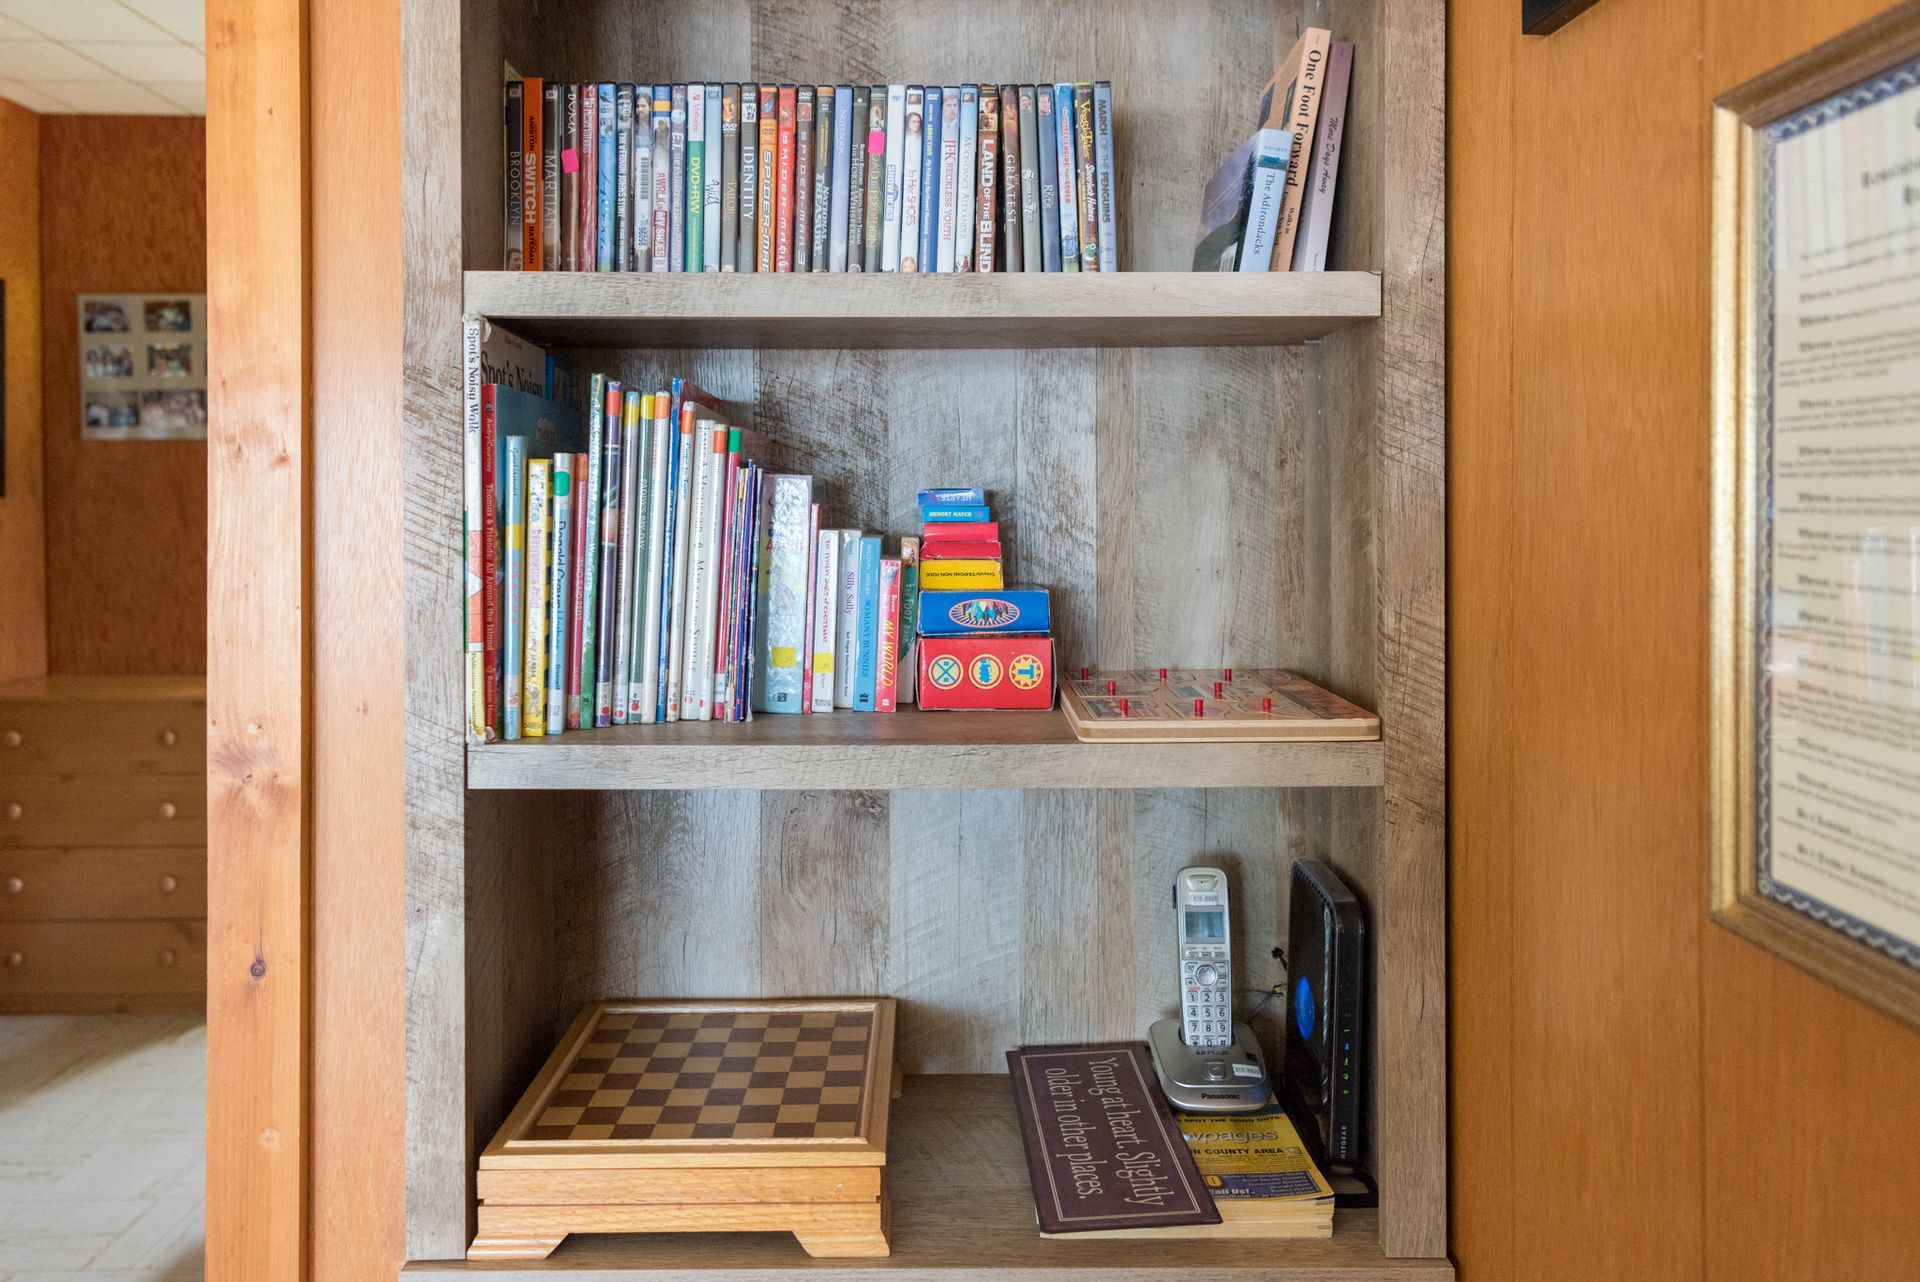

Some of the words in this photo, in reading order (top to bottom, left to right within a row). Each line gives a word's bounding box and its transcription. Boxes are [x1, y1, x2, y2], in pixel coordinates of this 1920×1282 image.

[1308, 49, 1322, 81] One
[1301, 85, 1316, 118] Foot
[838, 109, 848, 155] NOTEBOOK
[1079, 99, 1093, 160] VeggieTales
[1097, 99, 1108, 136] MARCH
[1325, 117, 1339, 141] More
[618, 132, 626, 145] THE
[671, 132, 684, 150] E.T.
[943, 138, 956, 162] JFK
[1099, 138, 1108, 152] OF
[618, 145, 627, 173] VERNON
[962, 136, 972, 189] MOONDANCE
[981, 139, 995, 187] LAND
[1100, 153, 1109, 170] THE
[1285, 123, 1309, 188] Forward
[1322, 142, 1335, 168] Days
[510, 151, 521, 225] BROOKLYN
[525, 153, 536, 224] SWITCH
[618, 174, 626, 197] JOHNS
[690, 157, 700, 214] DVD+RW
[743, 146, 754, 220] IDENTITY
[850, 158, 860, 190] HORSE
[907, 179, 916, 194] Her
[908, 169, 917, 178] In
[944, 162, 954, 208] RECKLESS
[1085, 164, 1095, 197] Sheerluck
[1264, 172, 1276, 192] The
[1319, 168, 1331, 194] Away
[545, 156, 557, 229] MARTIAN
[656, 178, 667, 203] WALK
[704, 180, 720, 206] Wild
[983, 187, 991, 198] OF
[1006, 154, 1016, 225] GREATEST
[1100, 171, 1111, 223] PENGUINS
[617, 197, 626, 218] STORY
[655, 211, 666, 226] MY
[813, 172, 824, 257] TREASURE
[821, 185, 830, 242] NATIONAL
[849, 190, 859, 246] WHISPERER
[906, 194, 916, 226] SHOES
[959, 190, 970, 240] ALEXANDER
[983, 198, 991, 220] THE
[1086, 197, 1097, 222] Holmes
[1285, 207, 1296, 226] Walks
[943, 209, 953, 240] YOUTH
[1253, 193, 1272, 255] Adirondacks
[1284, 227, 1291, 235] in
[655, 227, 666, 257] SHOES
[797, 249, 806, 266] 3
[980, 220, 992, 272] BLIND
[467, 328, 479, 363] Spot's
[468, 367, 479, 400] Noisy
[468, 402, 479, 433] Walk
[486, 484, 494, 517] Thomas
[486, 527, 495, 560] Friends:
[553, 521, 567, 565] Donald
[486, 563, 495, 574] All
[845, 571, 856, 591] Silly
[486, 576, 495, 605] Around
[843, 594, 855, 615] Sally
[864, 599, 872, 610] SO
[890, 594, 898, 612] Brown
[486, 608, 495, 621] the
[863, 610, 872, 638] MANY
[903, 598, 914, 622] FOOT
[486, 624, 495, 651] Island
[881, 618, 895, 640] MY
[861, 640, 871, 678] BUNNIES
[880, 641, 894, 687] WORLD
[1045, 1067, 1082, 1101] older
[1088, 1057, 1121, 1096] Young
[1053, 1099, 1086, 1112] in
[1100, 1097, 1134, 1110] at
[1057, 1114, 1097, 1150] other
[1106, 1110, 1148, 1149] heart.
[1184, 1130, 1278, 1145] wpages
[1056, 1152, 1107, 1199] places.
[1115, 1152, 1175, 1206] Slightly
